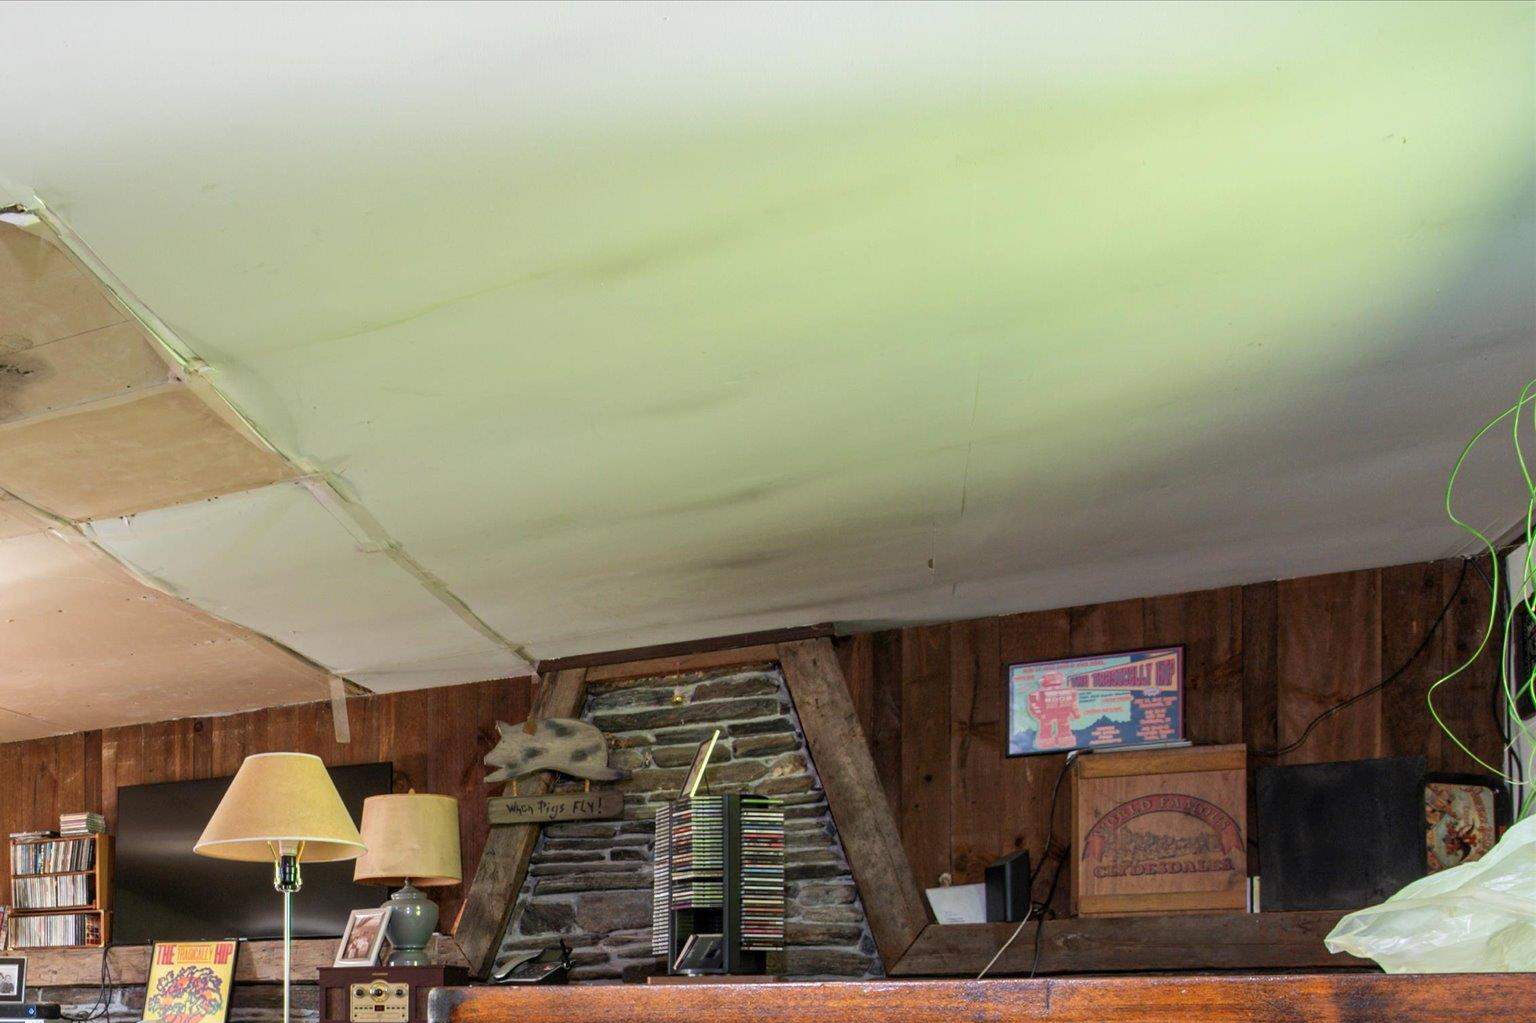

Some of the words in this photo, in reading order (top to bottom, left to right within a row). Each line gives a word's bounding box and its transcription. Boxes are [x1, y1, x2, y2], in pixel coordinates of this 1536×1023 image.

[537, 799, 565, 819] Pigs
[572, 797, 602, 815] FLY!
[156, 944, 177, 965] THE
[213, 942, 233, 965] HIP
